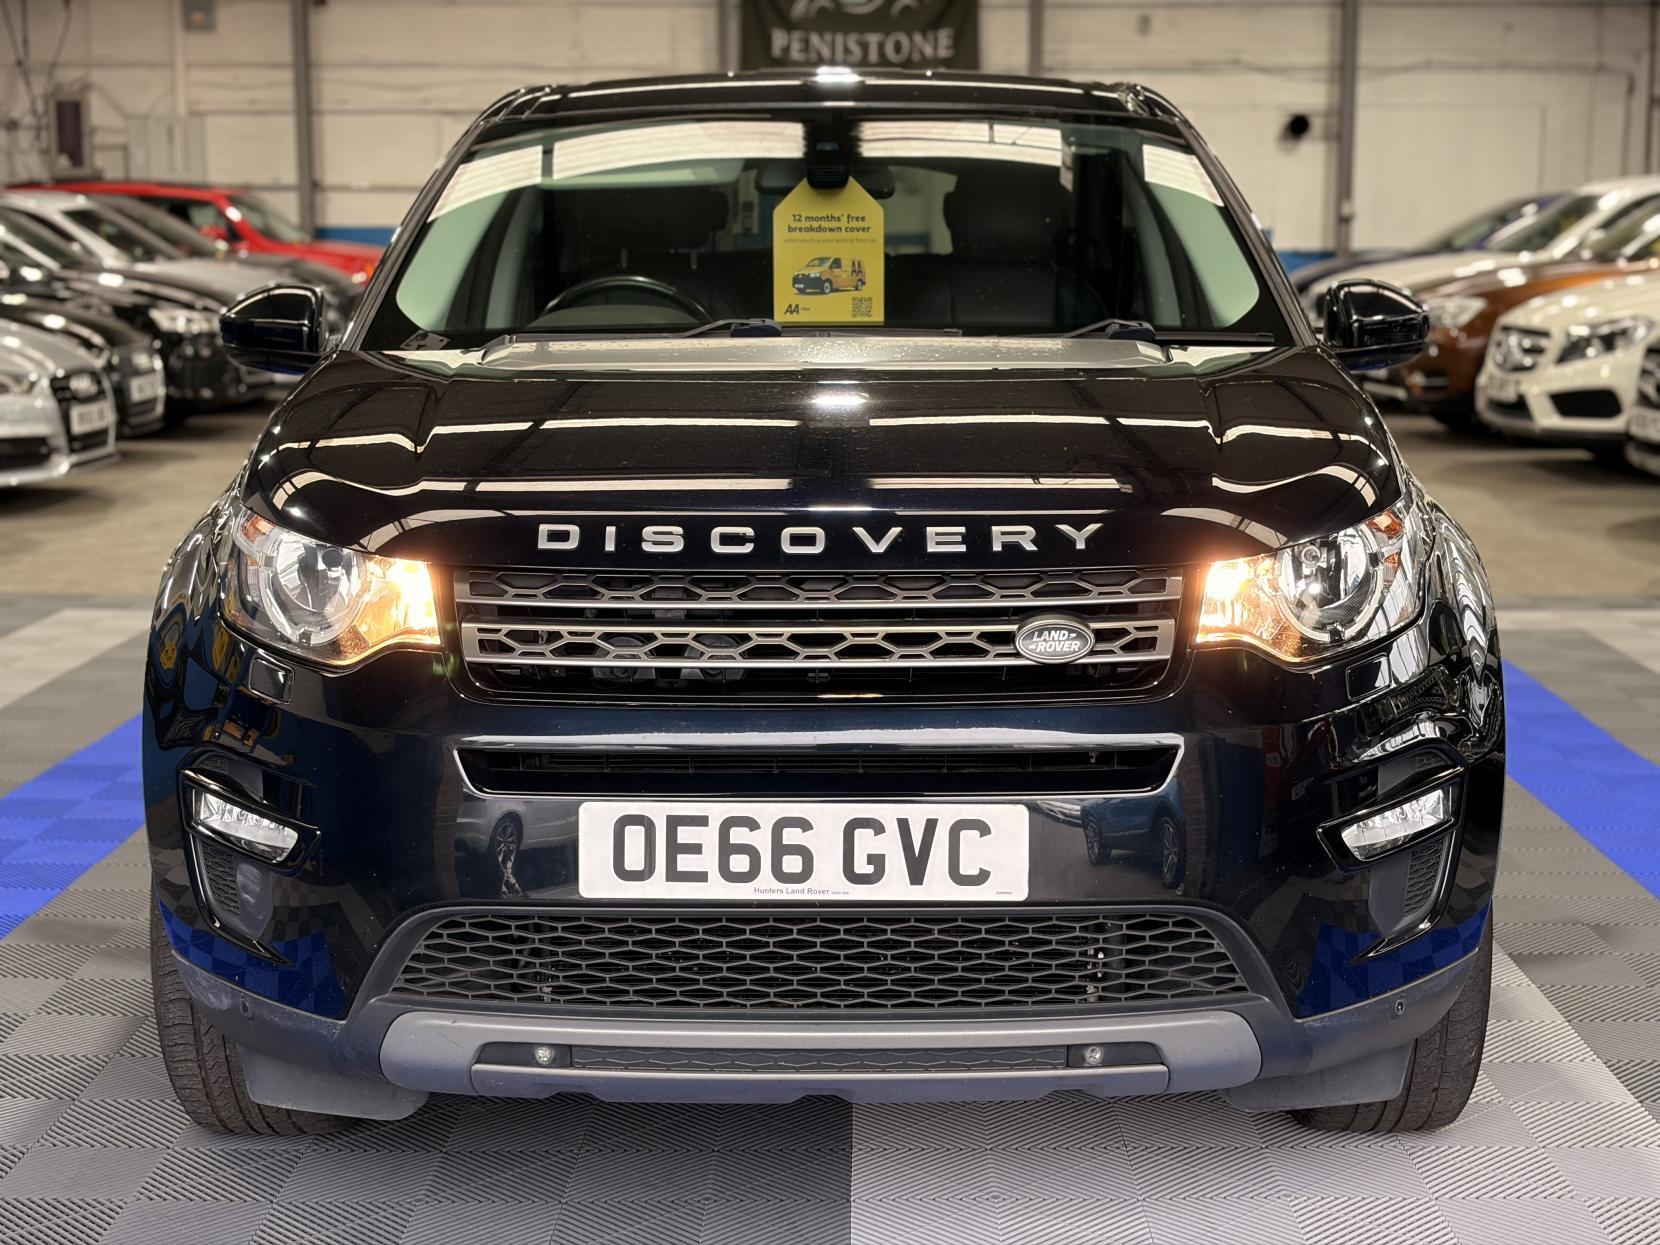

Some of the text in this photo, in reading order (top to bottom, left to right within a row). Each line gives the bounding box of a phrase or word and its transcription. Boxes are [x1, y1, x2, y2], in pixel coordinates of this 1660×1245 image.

[770, 27, 955, 64] PENISTONE
[792, 214, 802, 222] 12
[847, 213, 866, 224] free
[787, 224, 842, 233] breakdown
[851, 260, 863, 277] AA
[784, 304, 800, 315] AA
[537, 522, 1103, 554] DISCOVERY
[1032, 630, 1069, 642] LAND
[1036, 640, 1081, 652] ROVER
[612, 813, 993, 887] OE66 GVC
[753, 887, 784, 895] Hunters
[785, 887, 805, 895] Land
[807, 887, 830, 895] Rover
